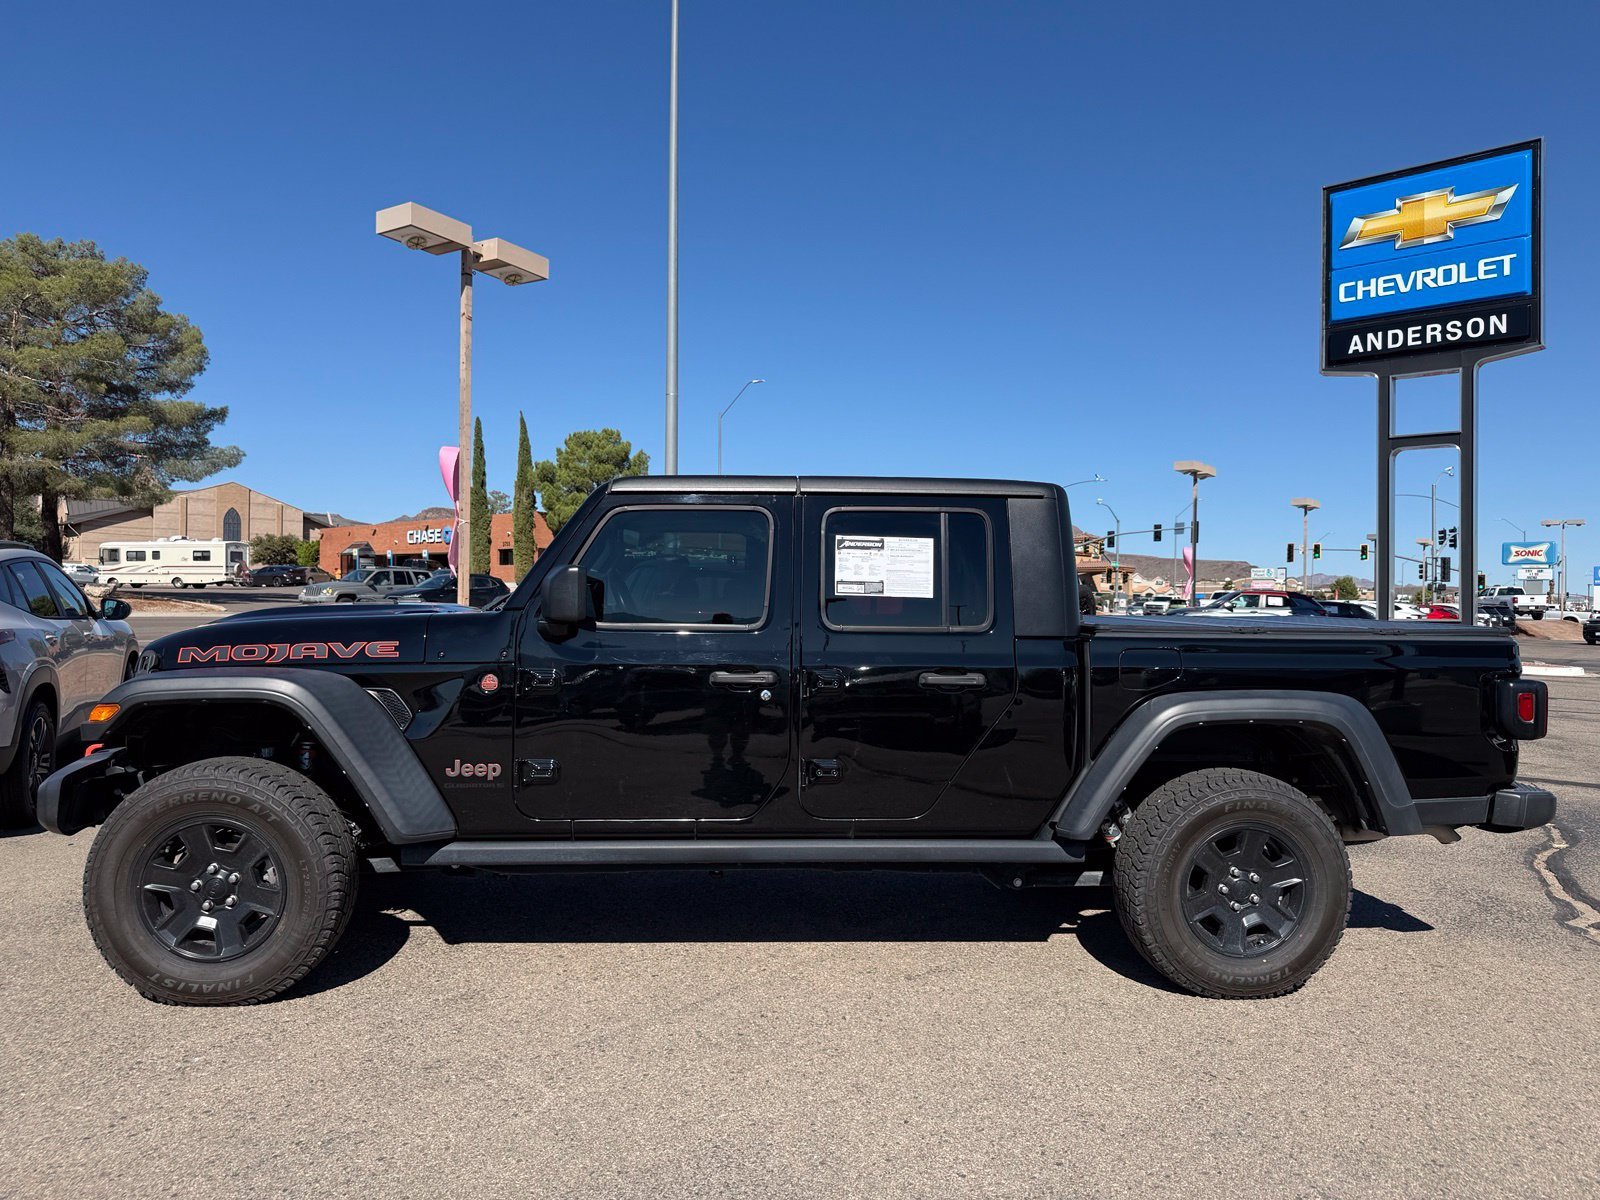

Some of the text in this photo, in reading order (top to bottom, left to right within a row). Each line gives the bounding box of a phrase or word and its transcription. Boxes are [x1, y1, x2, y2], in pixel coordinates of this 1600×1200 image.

[1338, 253, 1517, 303] CHEVROLET
[1348, 314, 1508, 354] ANDERSON
[407, 529, 442, 544] CHASE
[1514, 549, 1543, 557] SONIC
[177, 640, 400, 664] MOJAVE
[445, 759, 502, 780] Jeep
[248, 804, 281, 823] A/T
[147, 972, 254, 994] FINALIST
